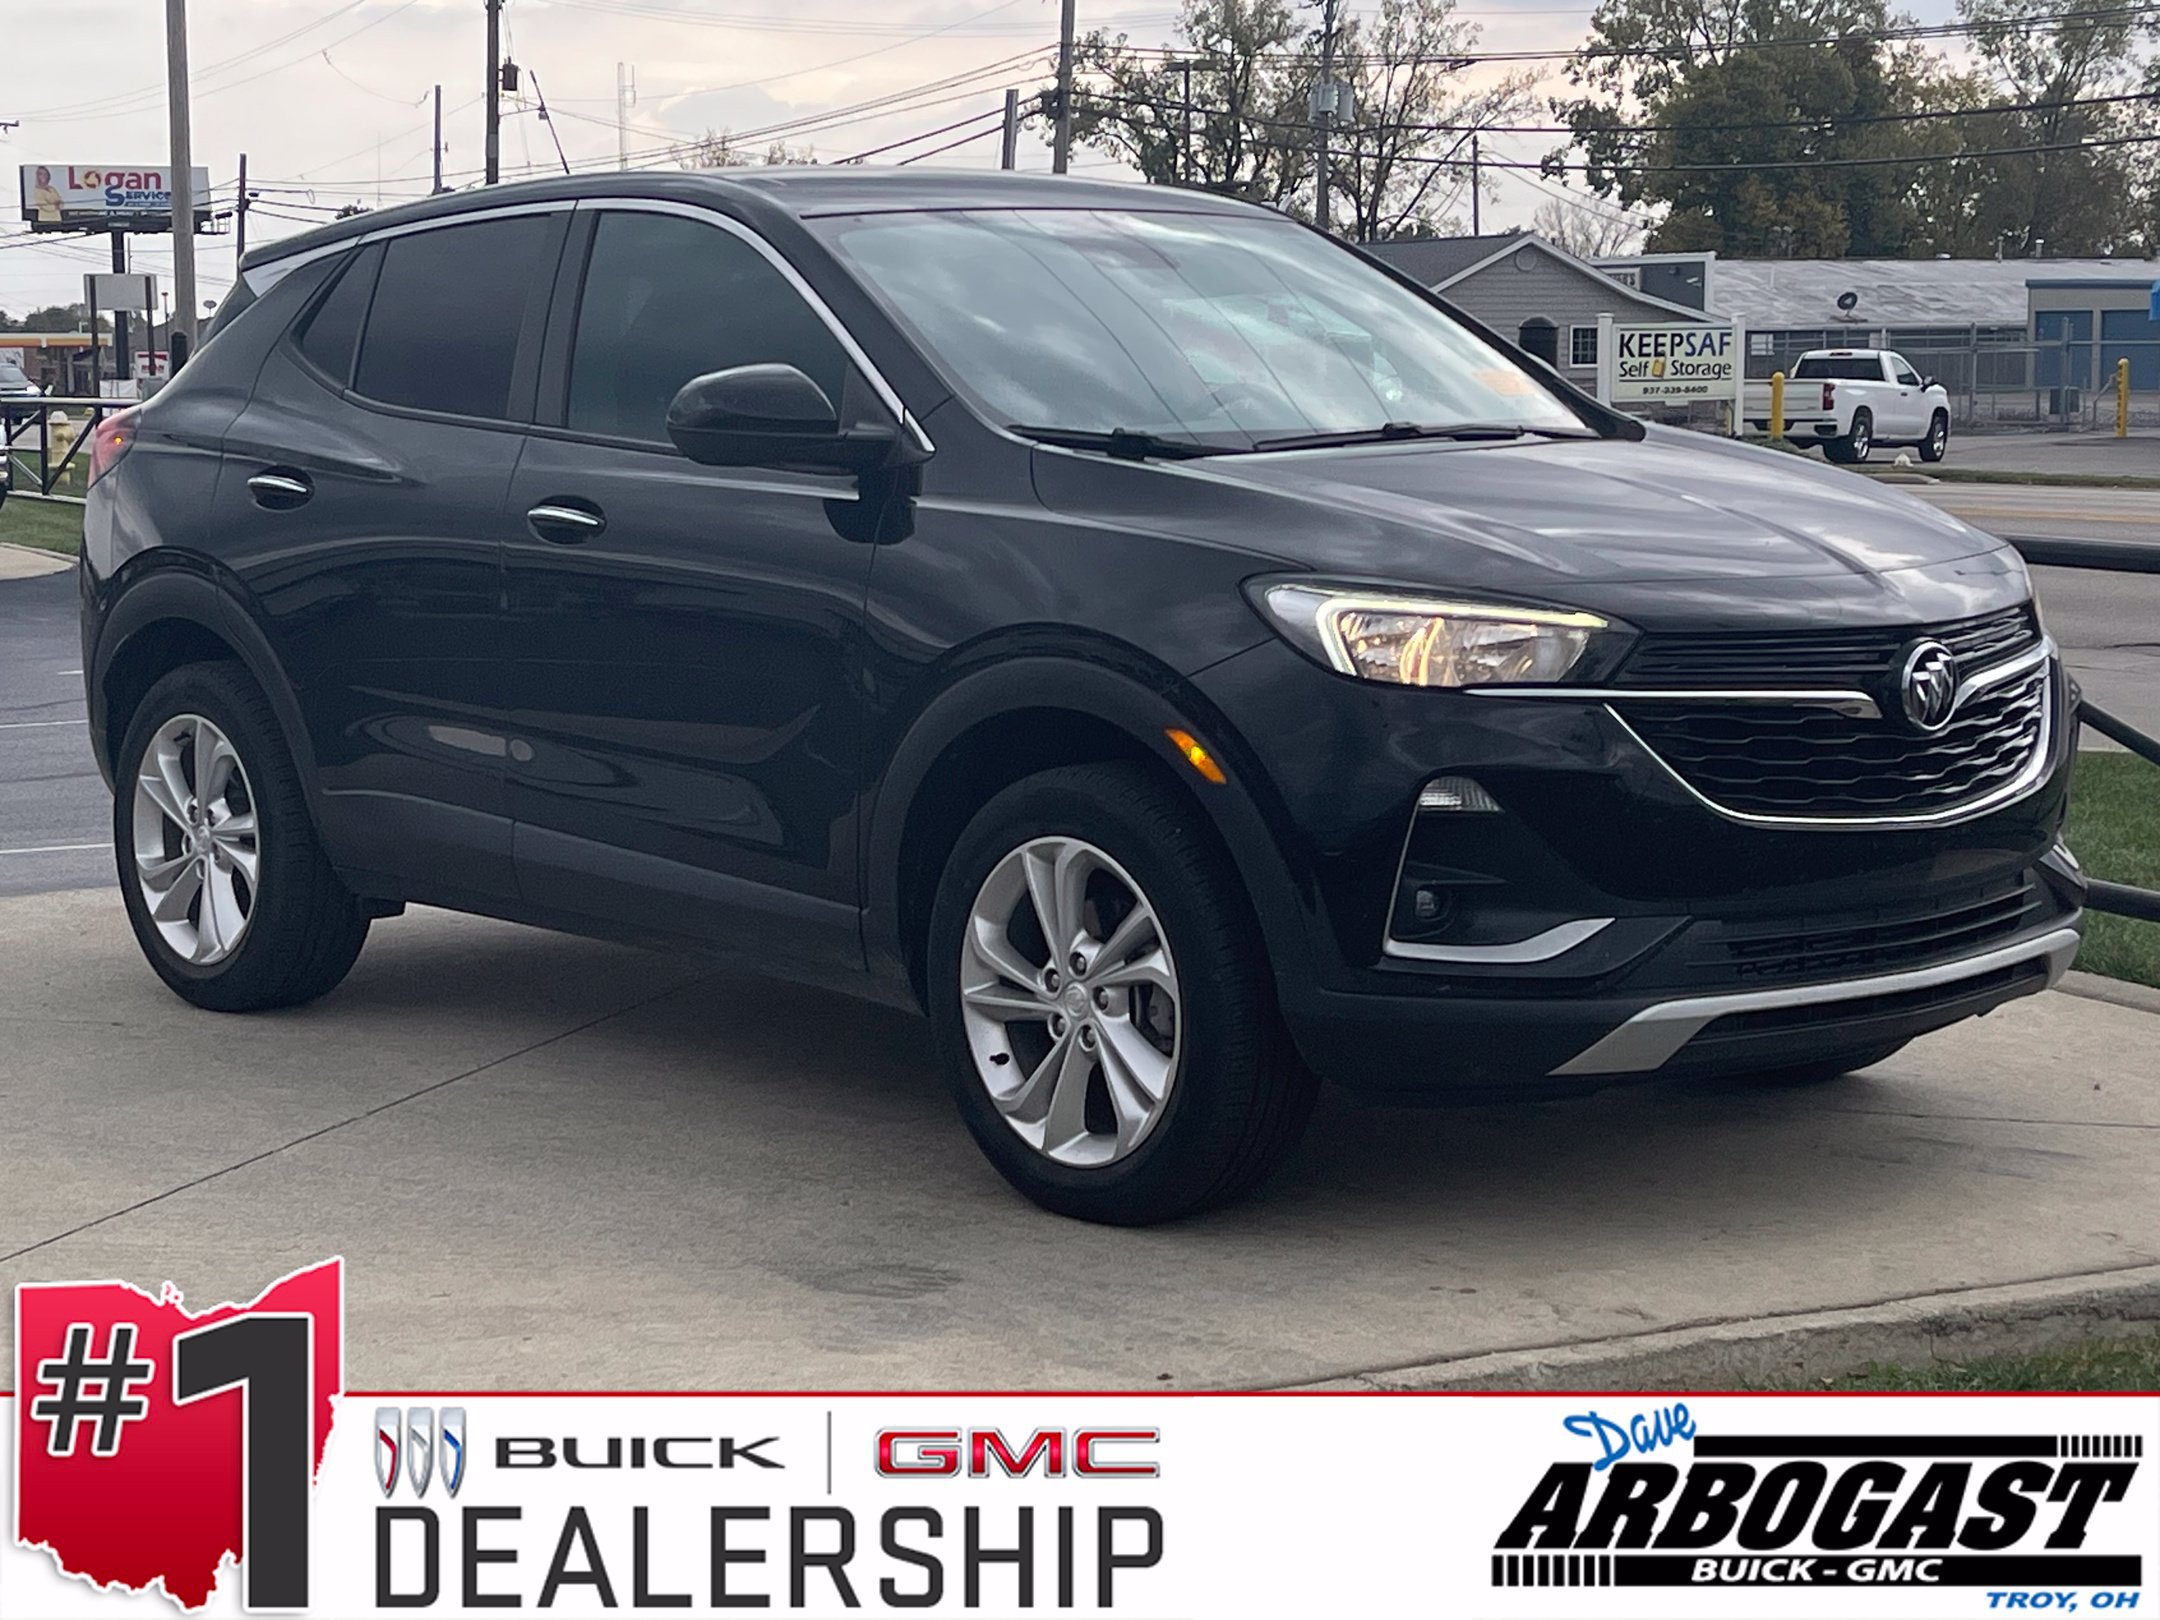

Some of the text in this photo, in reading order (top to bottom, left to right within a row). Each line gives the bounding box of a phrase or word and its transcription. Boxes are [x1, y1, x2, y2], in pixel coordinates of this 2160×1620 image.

[68, 166, 162, 191] Logan
[1619, 332, 1733, 358] KEEPSAF
[1619, 359, 1732, 380] Self Storage
